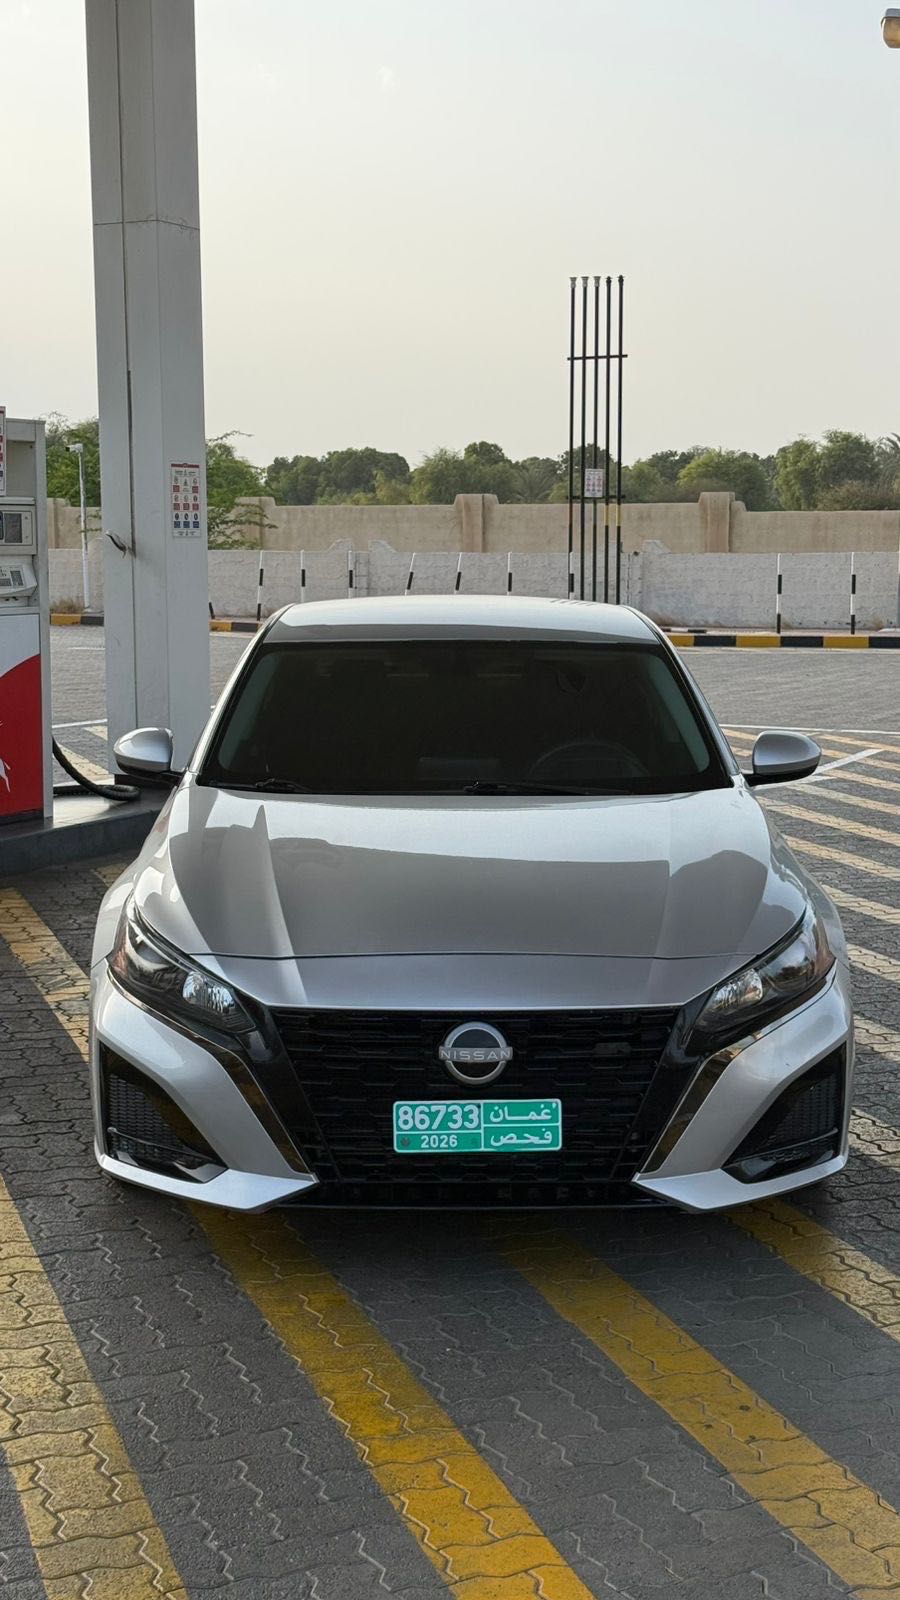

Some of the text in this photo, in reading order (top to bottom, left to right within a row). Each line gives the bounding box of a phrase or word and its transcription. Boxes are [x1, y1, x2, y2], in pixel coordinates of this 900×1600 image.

[441, 1050, 511, 1060] NISSAN
[398, 1104, 479, 1130] 86733
[421, 1135, 458, 1148] 2026
[490, 1128, 552, 1146] فحص
